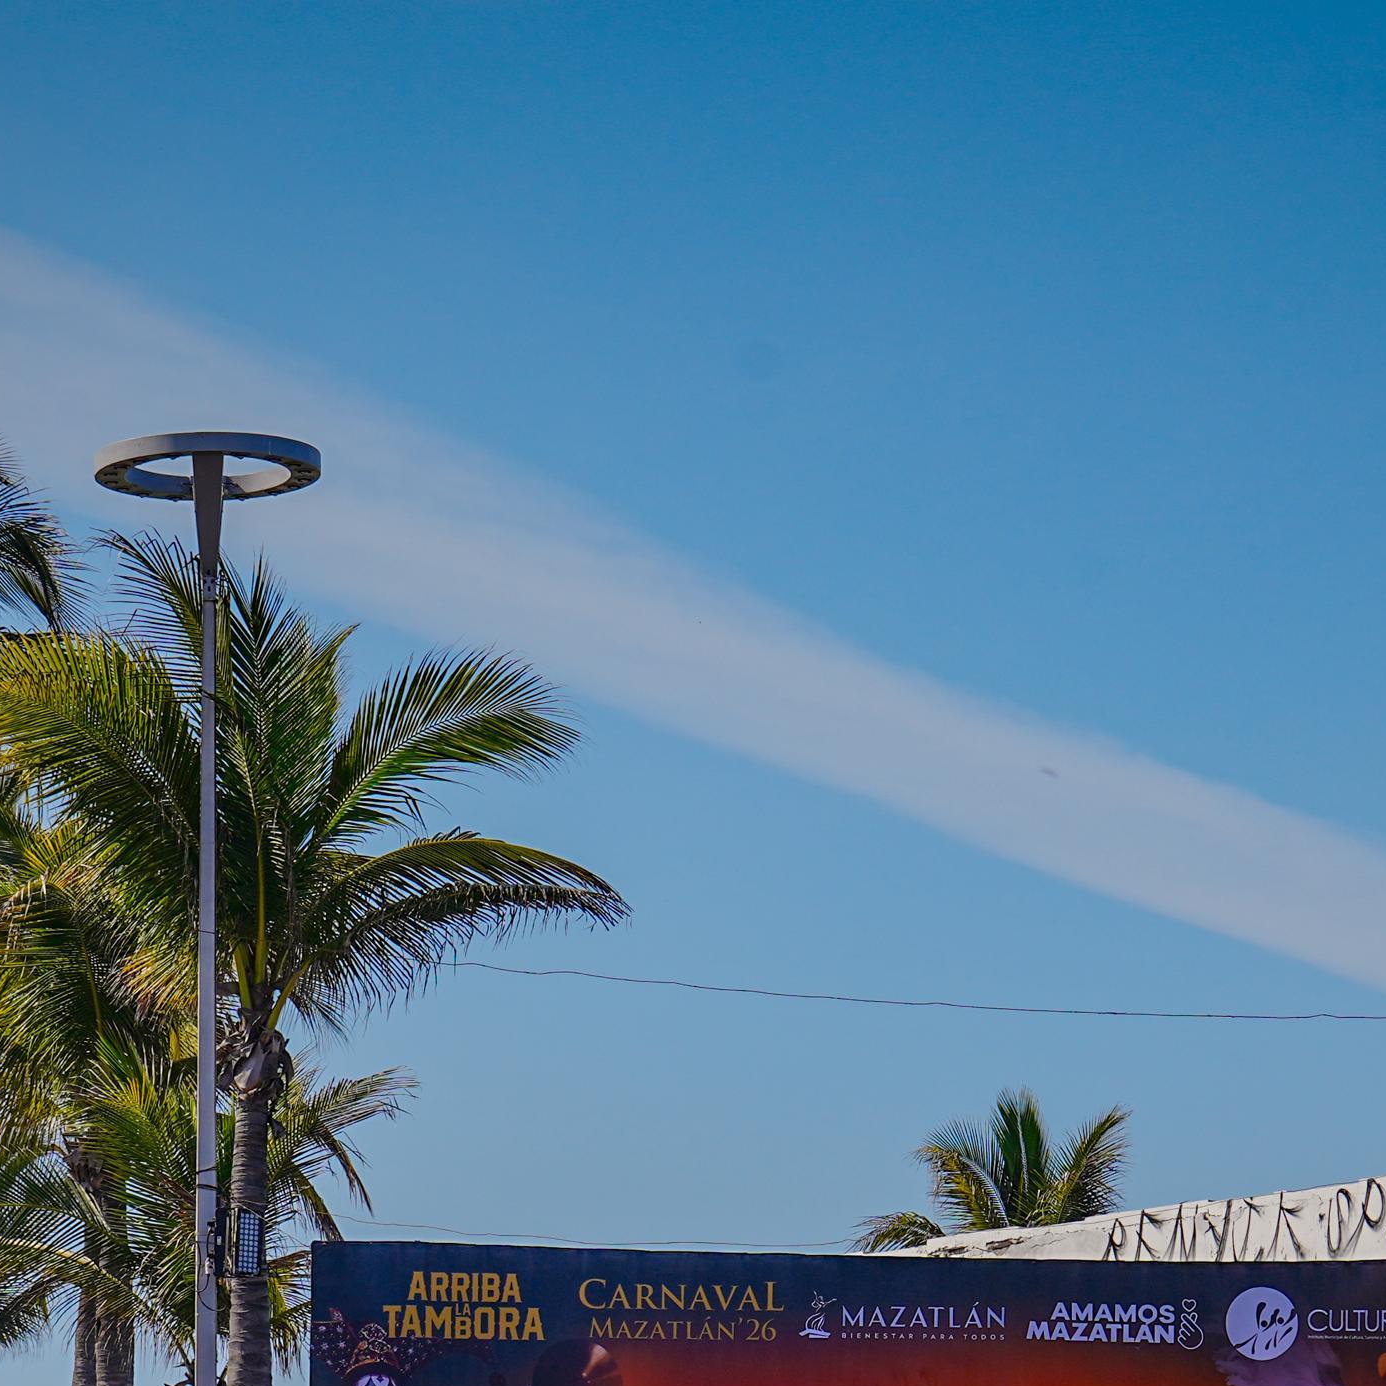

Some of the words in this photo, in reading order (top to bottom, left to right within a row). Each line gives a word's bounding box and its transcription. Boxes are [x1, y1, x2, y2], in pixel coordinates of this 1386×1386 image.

[407, 1271, 523, 1303] ARRIBA
[579, 1278, 785, 1312] CARNAVAL
[383, 1305, 546, 1341] TAMBORA
[455, 1303, 471, 1316] LA
[841, 1301, 1006, 1328] MAZATLÁN
[1050, 1302, 1176, 1325] AMAMOS
[841, 1332, 914, 1340] BIENESTAR
[963, 1333, 1006, 1341] TODOS
